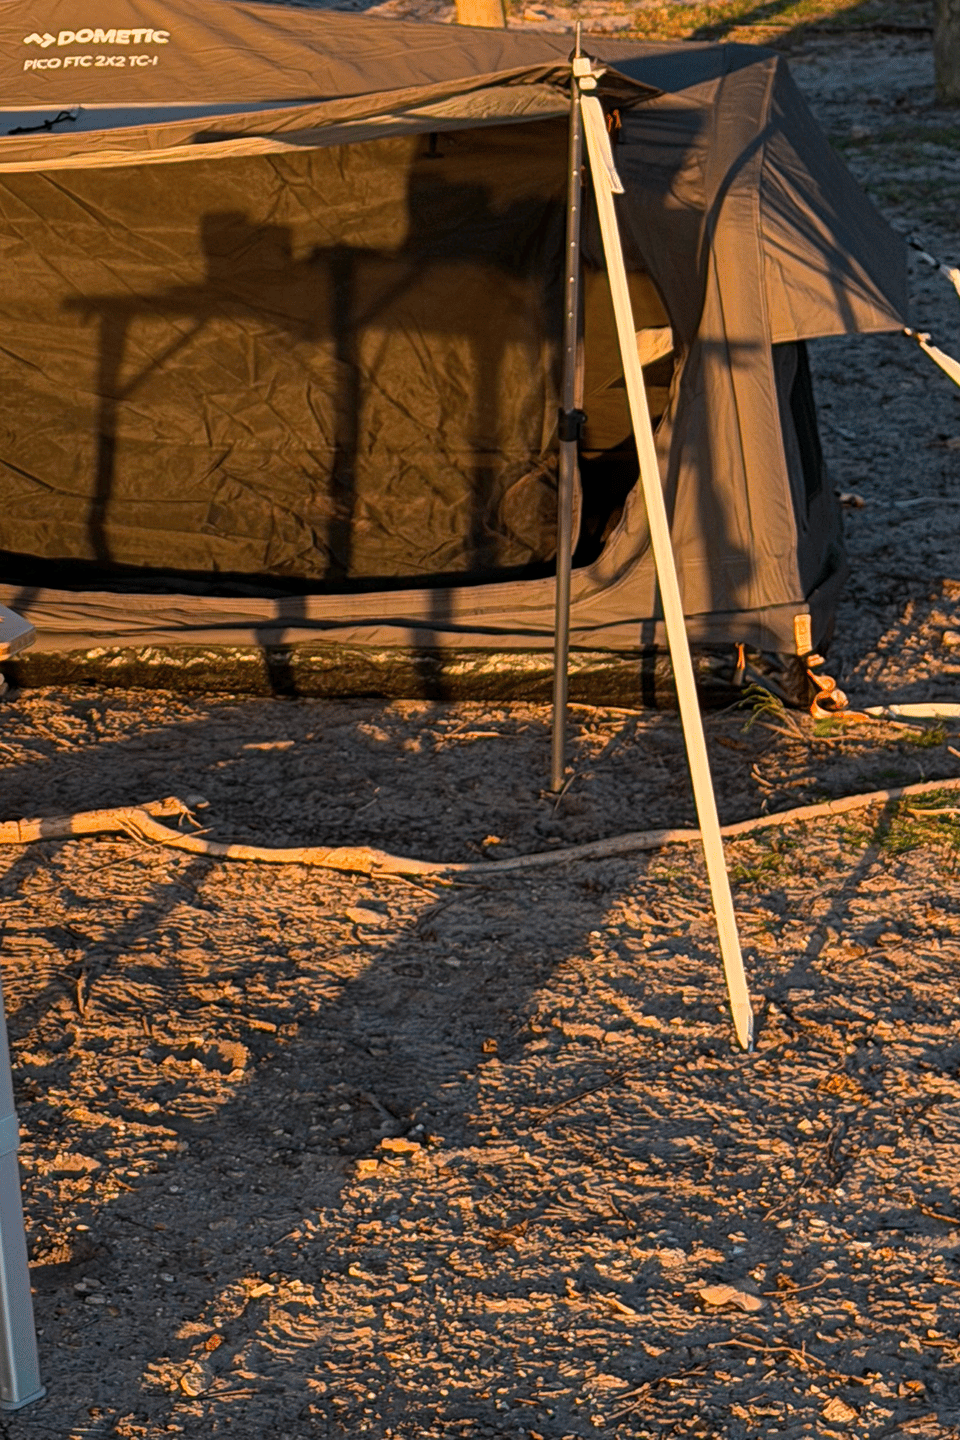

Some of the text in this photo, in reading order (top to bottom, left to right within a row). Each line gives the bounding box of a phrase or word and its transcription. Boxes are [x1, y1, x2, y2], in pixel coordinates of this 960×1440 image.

[57, 28, 170, 46] DOMETIC
[23, 58, 61, 71] PICO
[63, 56, 93, 68] FTC
[94, 56, 126, 68] 2X2
